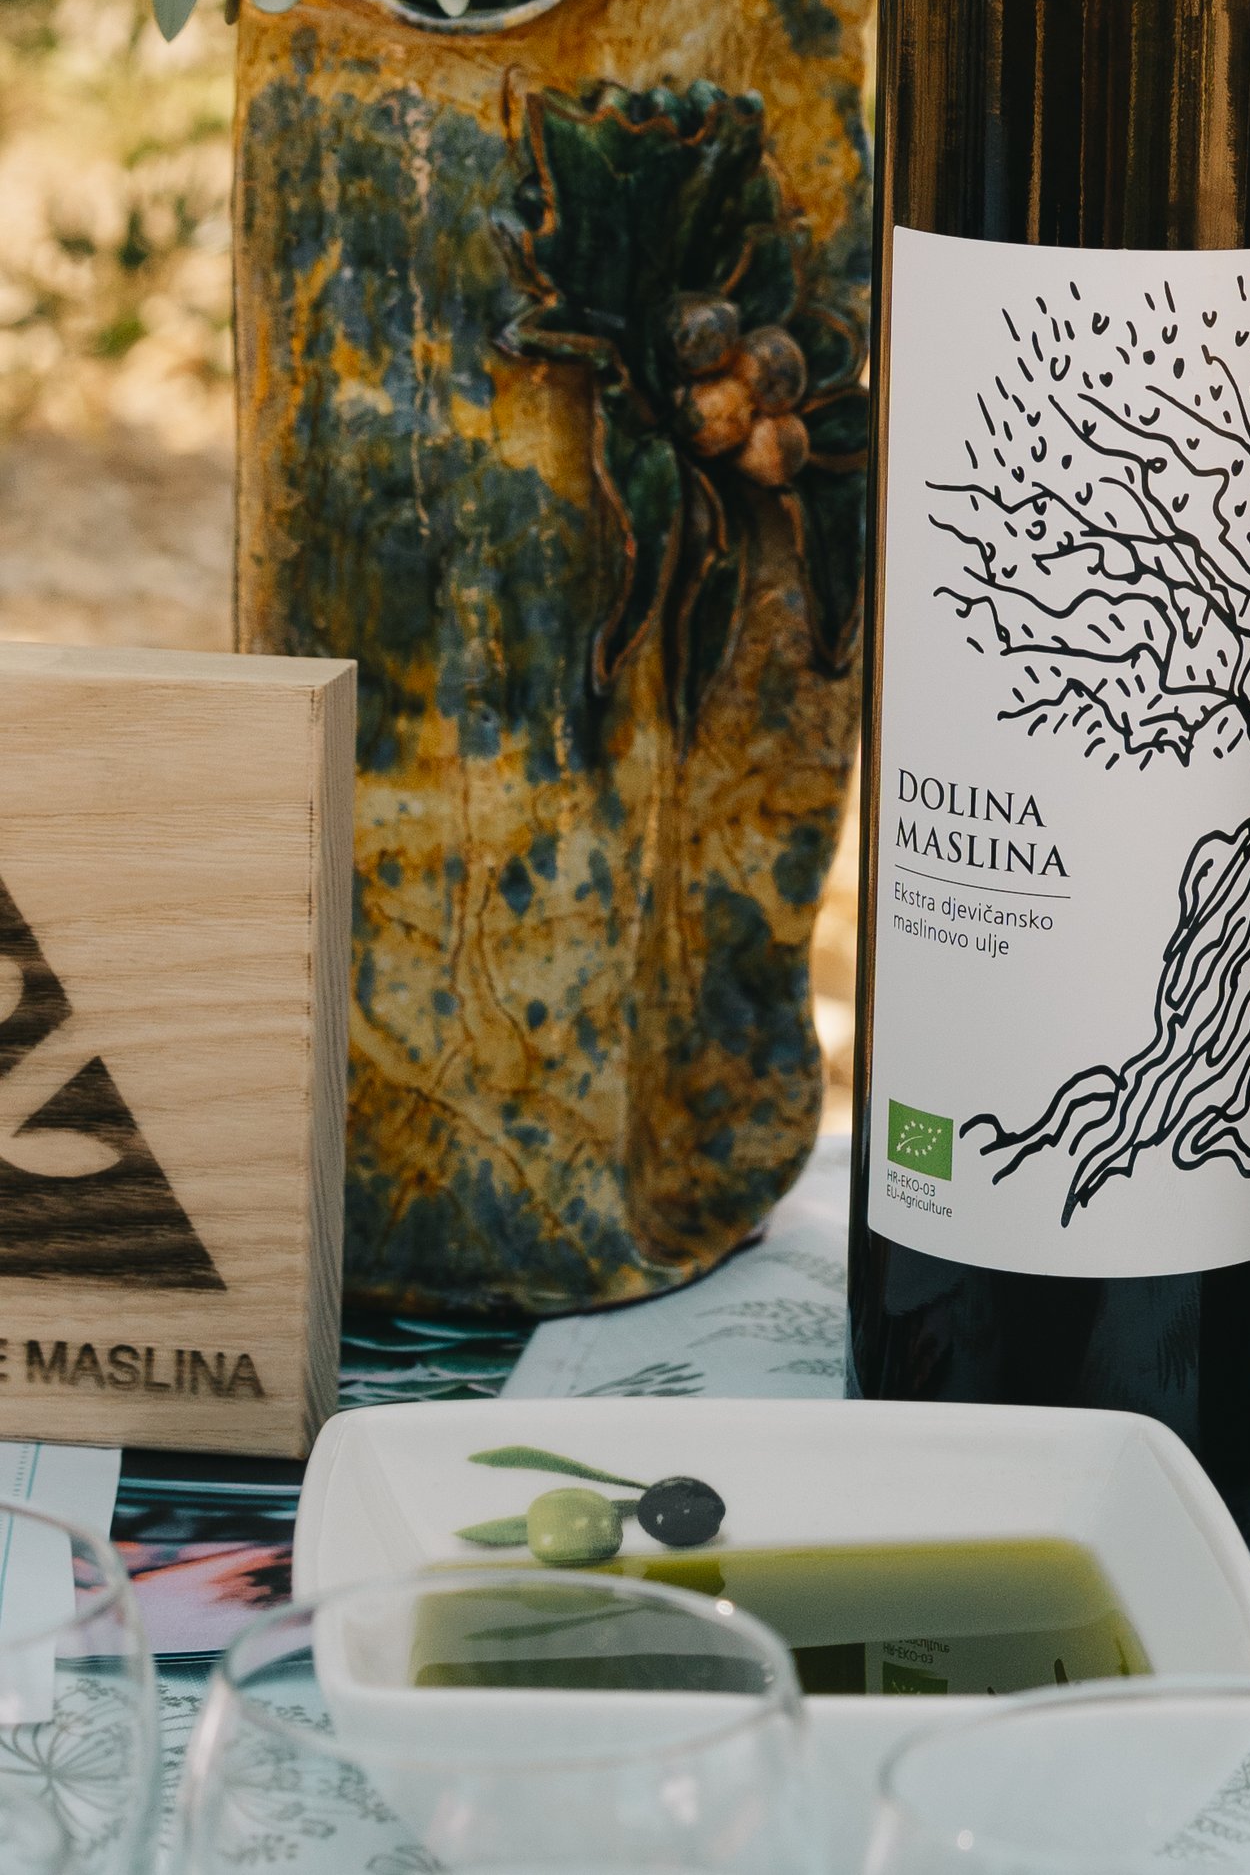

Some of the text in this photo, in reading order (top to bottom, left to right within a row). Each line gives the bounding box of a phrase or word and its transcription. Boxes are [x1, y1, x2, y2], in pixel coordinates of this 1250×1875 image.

[898, 768, 1047, 828] DOLINA
[895, 816, 1071, 877] MASLINA
[894, 881, 1053, 930] Ekstra djevičansko
[893, 914, 1009, 958] maslinovo ulje
[886, 1168, 936, 1197] HR-EKO-03
[886, 1184, 953, 1218] EU-Agriculture
[25, 1339, 266, 1399] MASLINA
